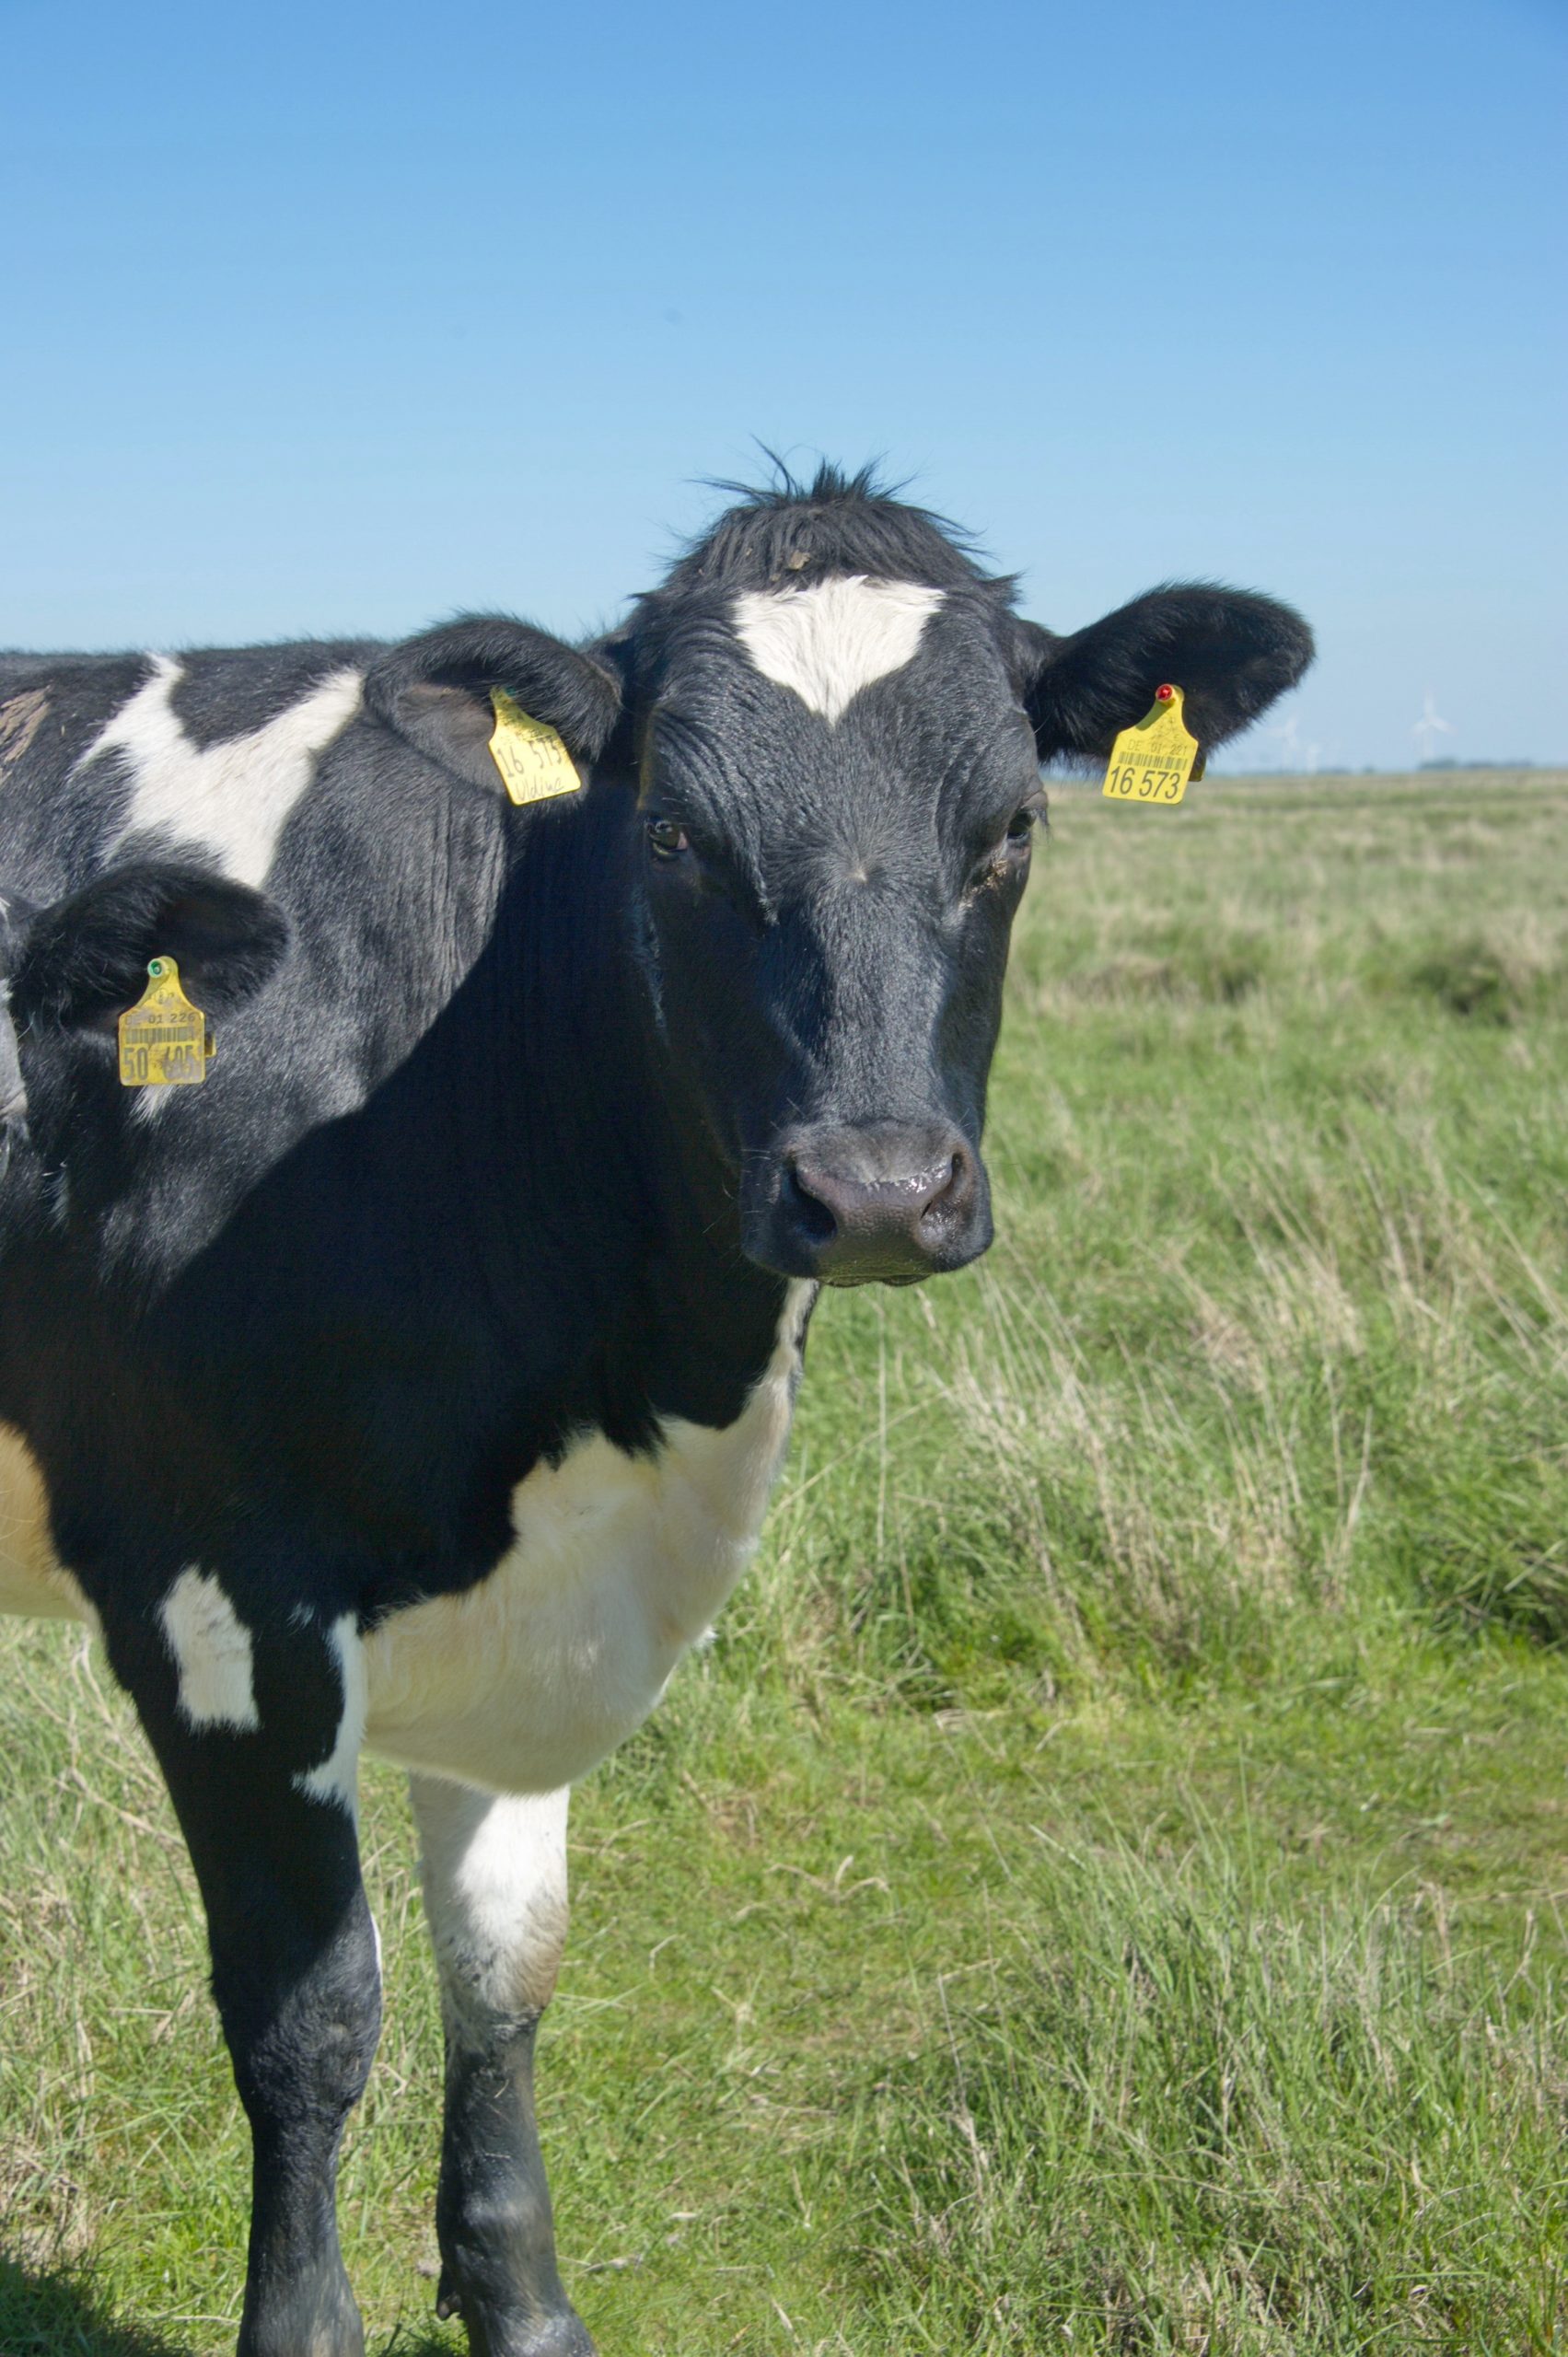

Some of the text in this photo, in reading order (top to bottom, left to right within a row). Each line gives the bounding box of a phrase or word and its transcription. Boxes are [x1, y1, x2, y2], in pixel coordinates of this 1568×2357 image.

[497, 745, 525, 777] 16
[1127, 739, 1144, 751] DE
[1110, 766, 1181, 799] 16 573
[148, 1015, 163, 1024] 01
[123, 1047, 148, 1081] 50
